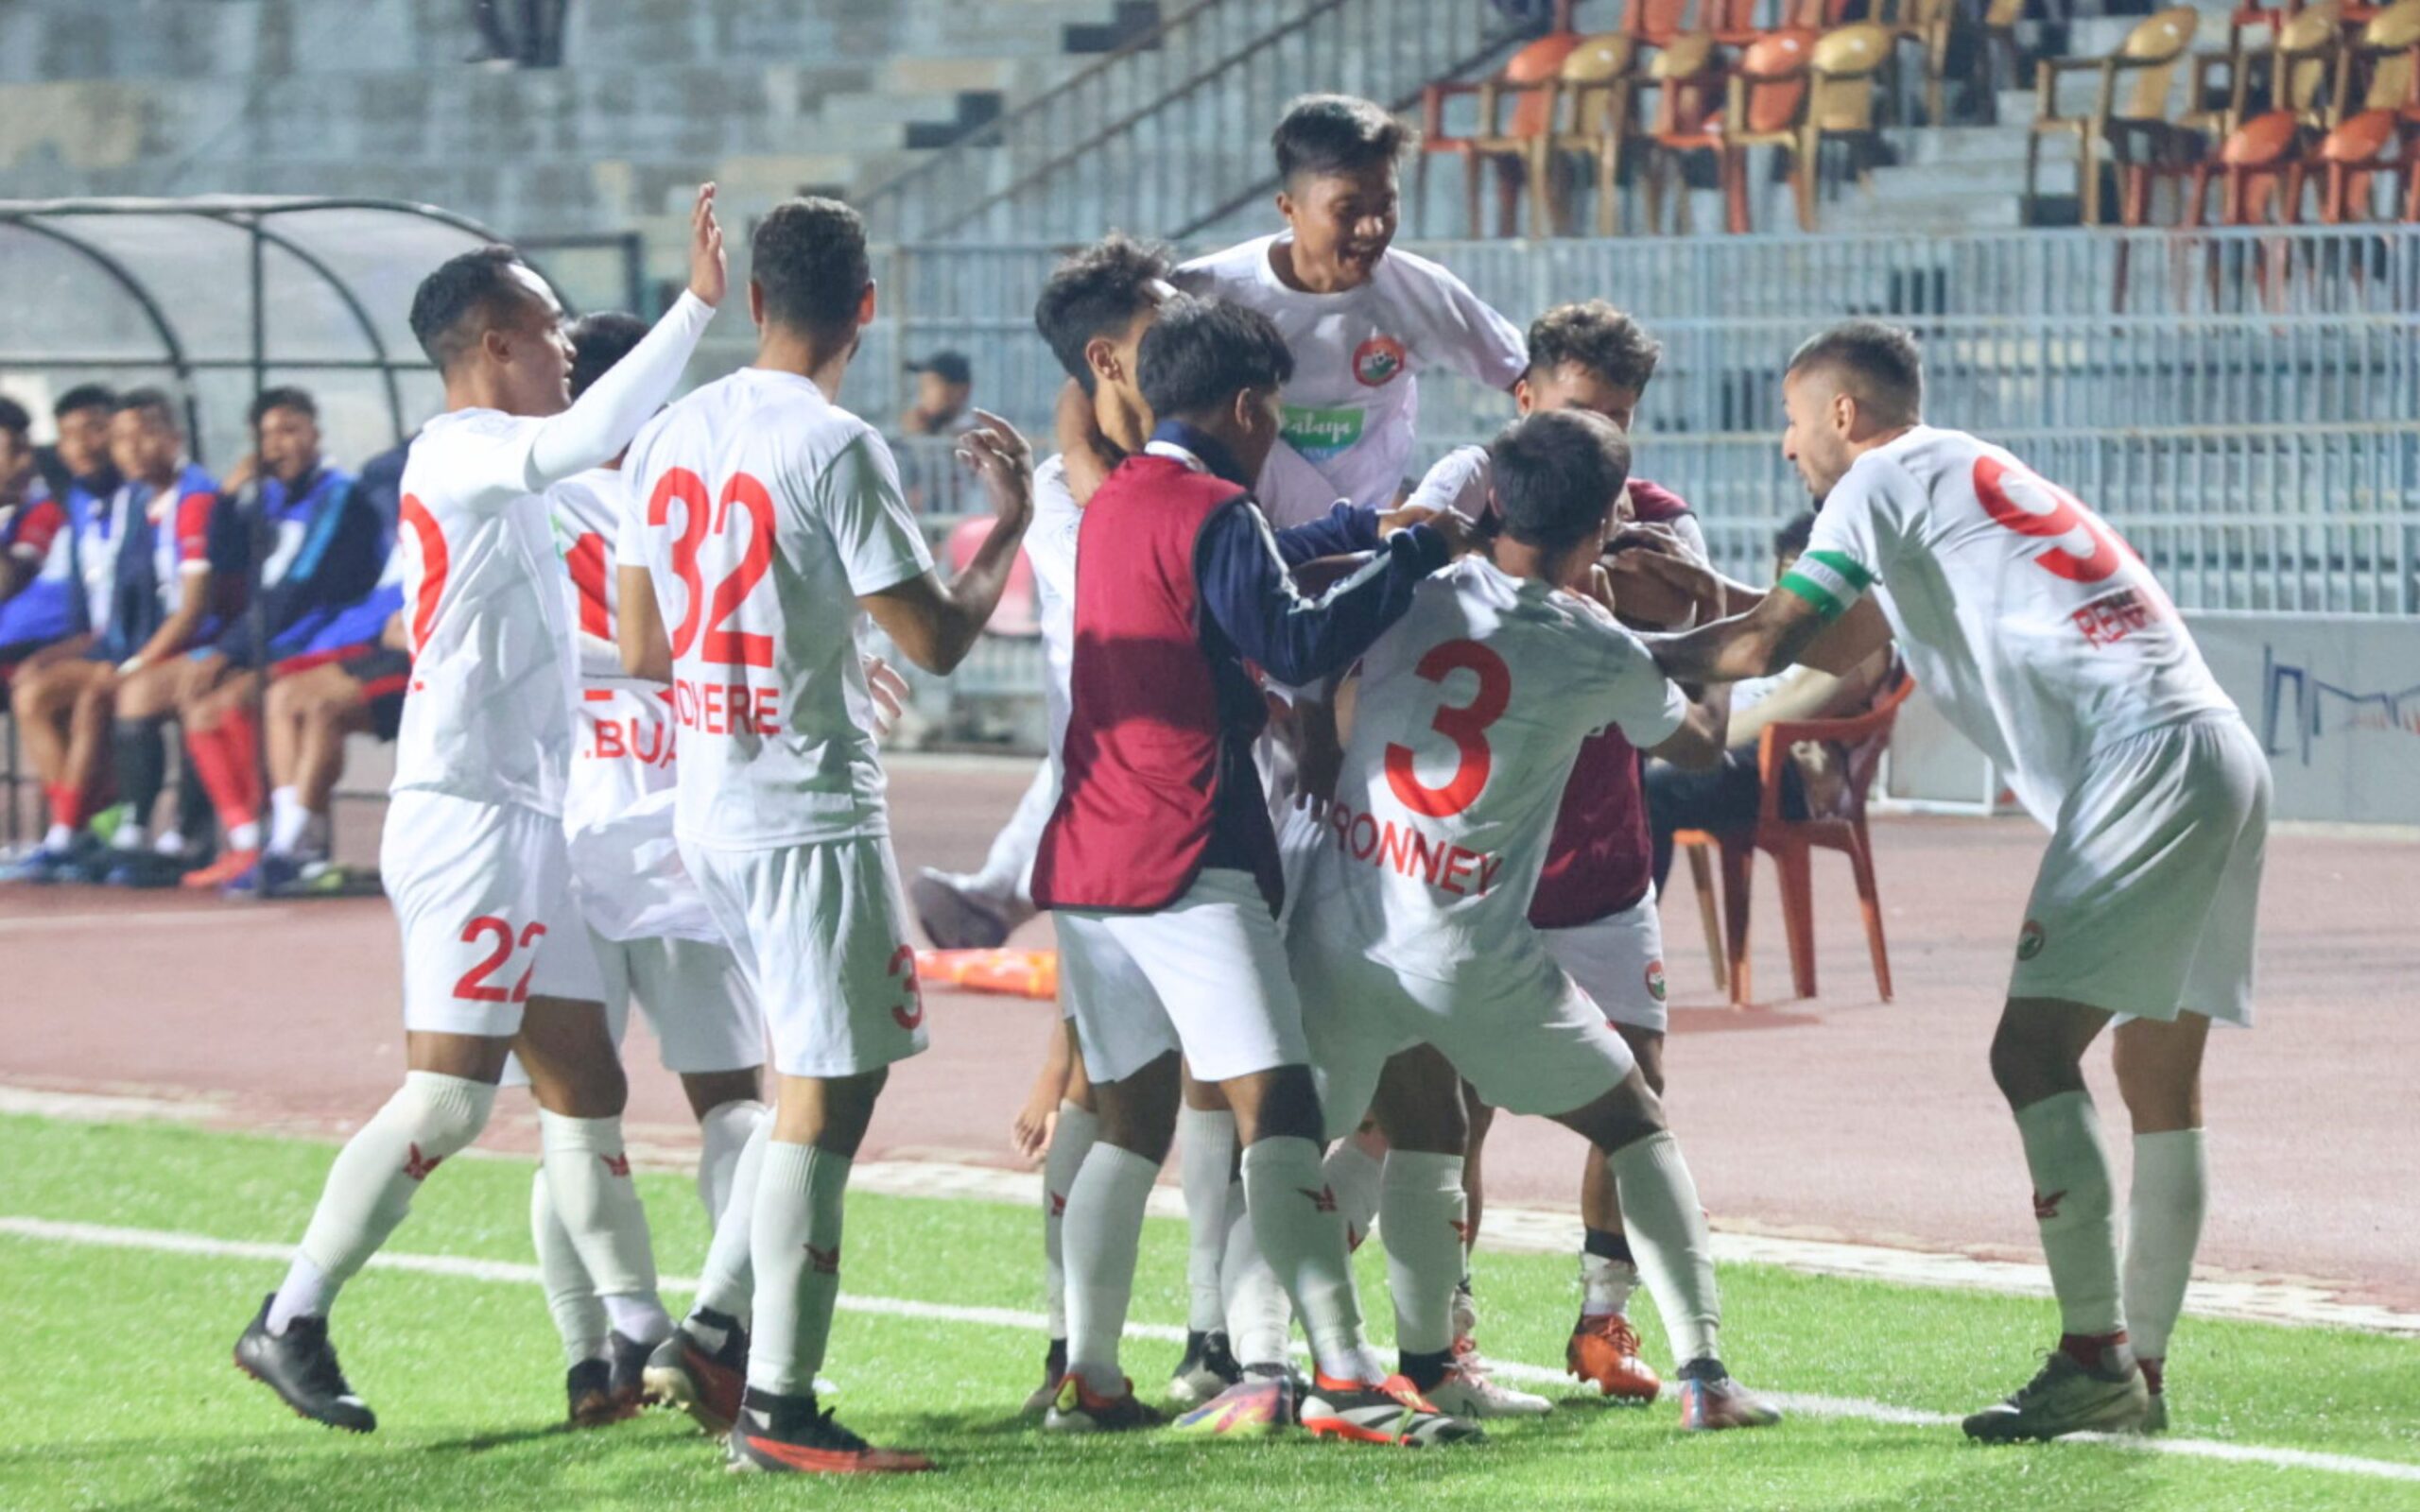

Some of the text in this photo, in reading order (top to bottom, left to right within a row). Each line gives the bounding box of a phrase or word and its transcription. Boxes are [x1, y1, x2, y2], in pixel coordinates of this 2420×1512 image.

[648, 467, 776, 667] 32
[1973, 455, 2144, 583] 9
[1384, 639, 1512, 818] 3
[1333, 804, 1503, 897] RONNEY
[889, 944, 923, 1030] 3
